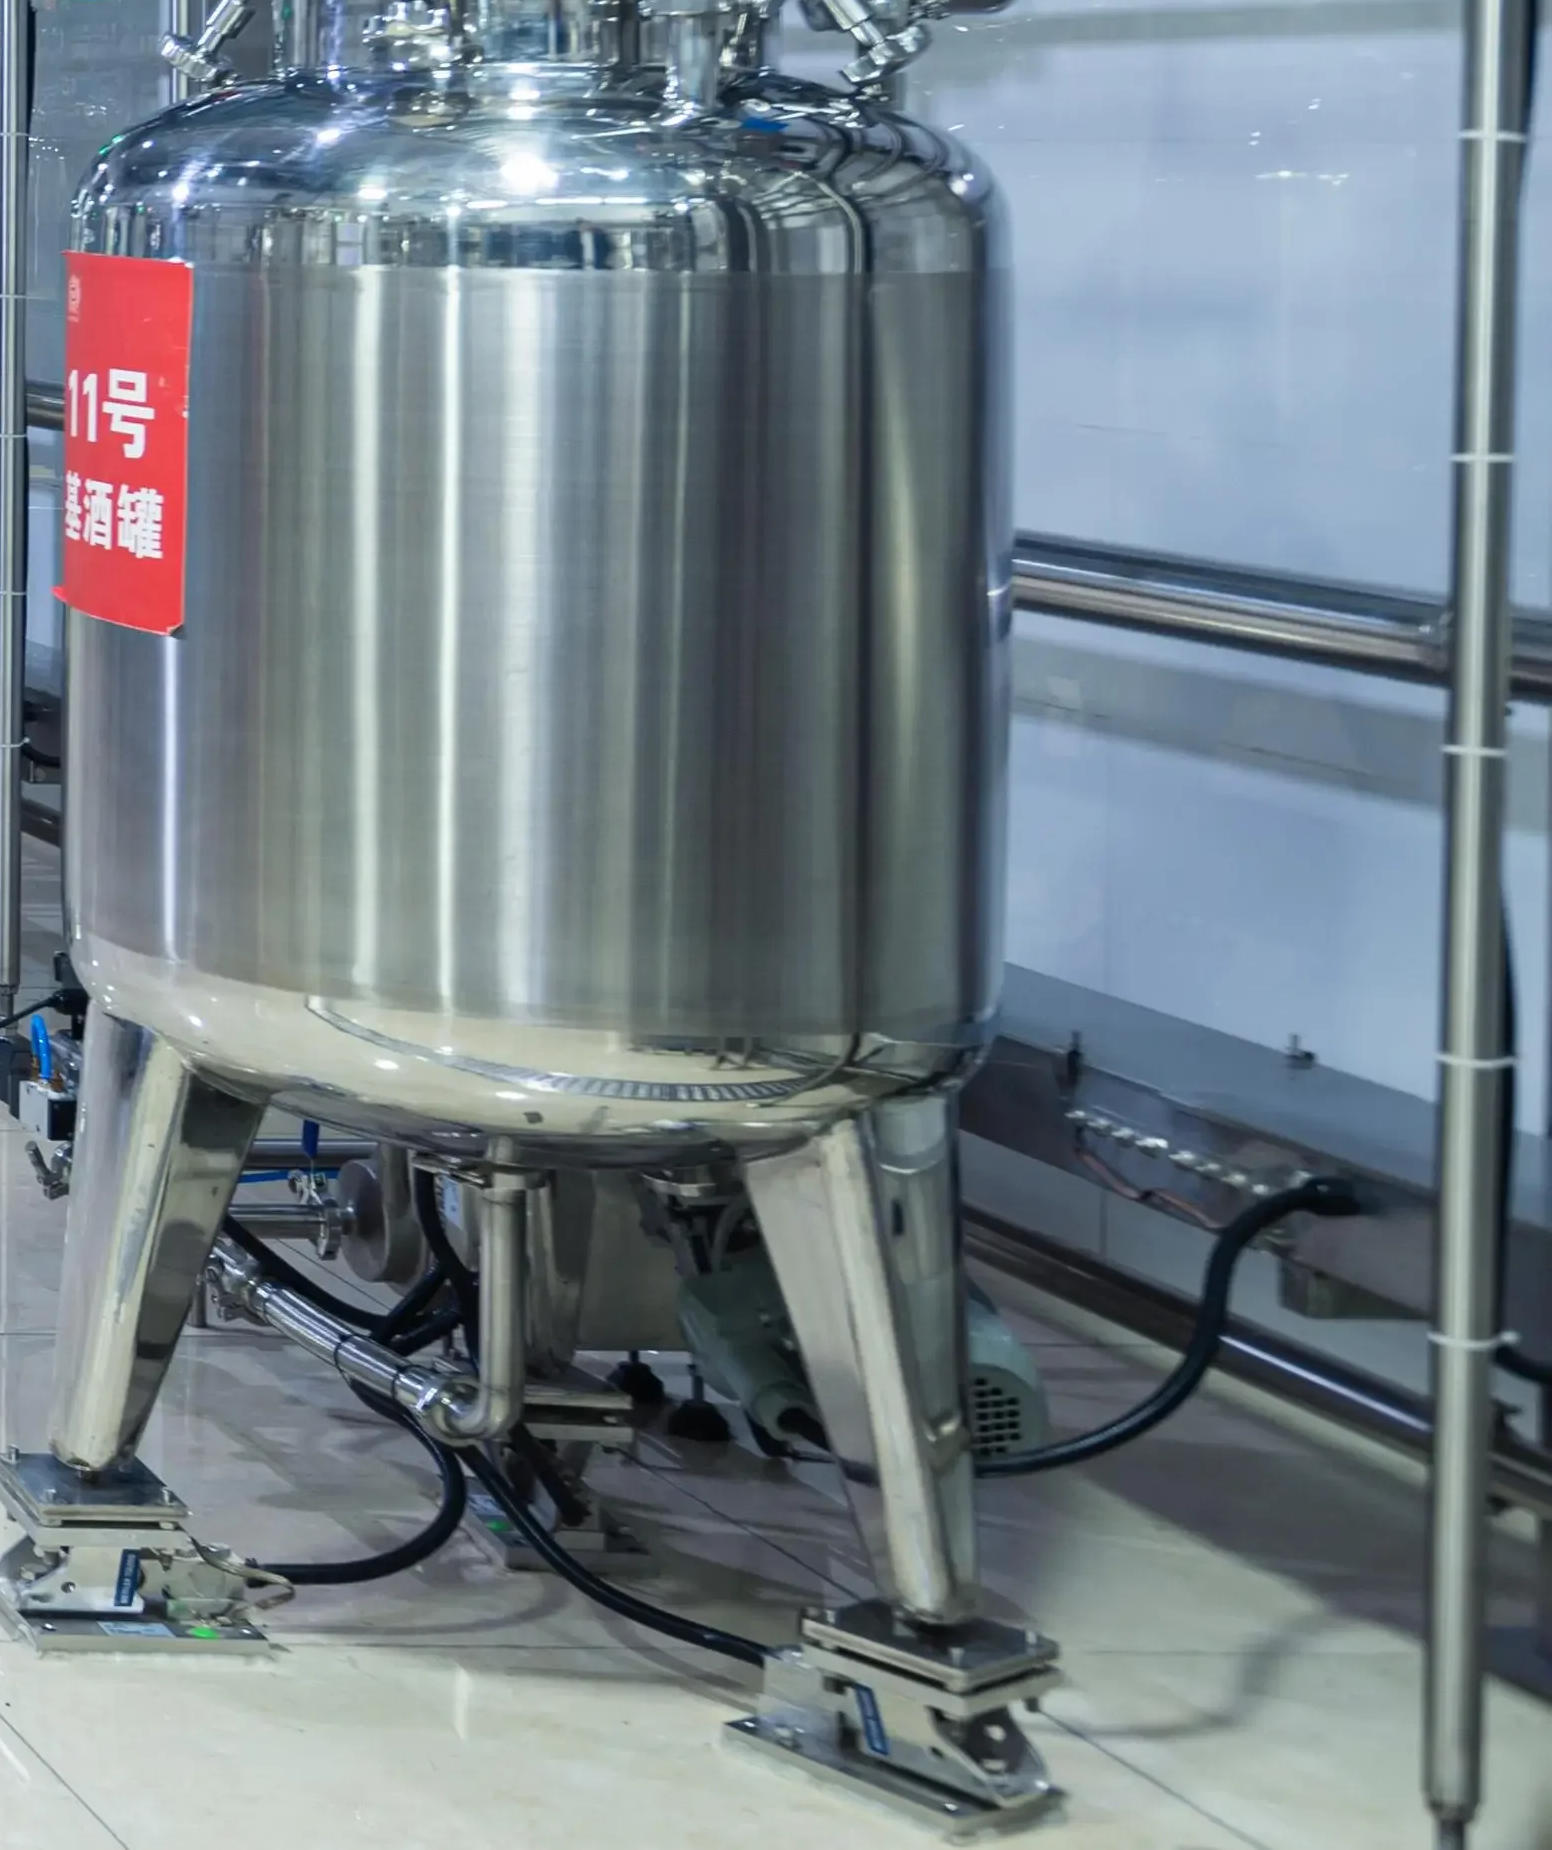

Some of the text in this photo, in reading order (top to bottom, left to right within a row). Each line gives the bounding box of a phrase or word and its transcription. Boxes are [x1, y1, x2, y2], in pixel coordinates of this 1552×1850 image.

[68, 368, 155, 459] 11号
[65, 470, 164, 559] 基酒罐
